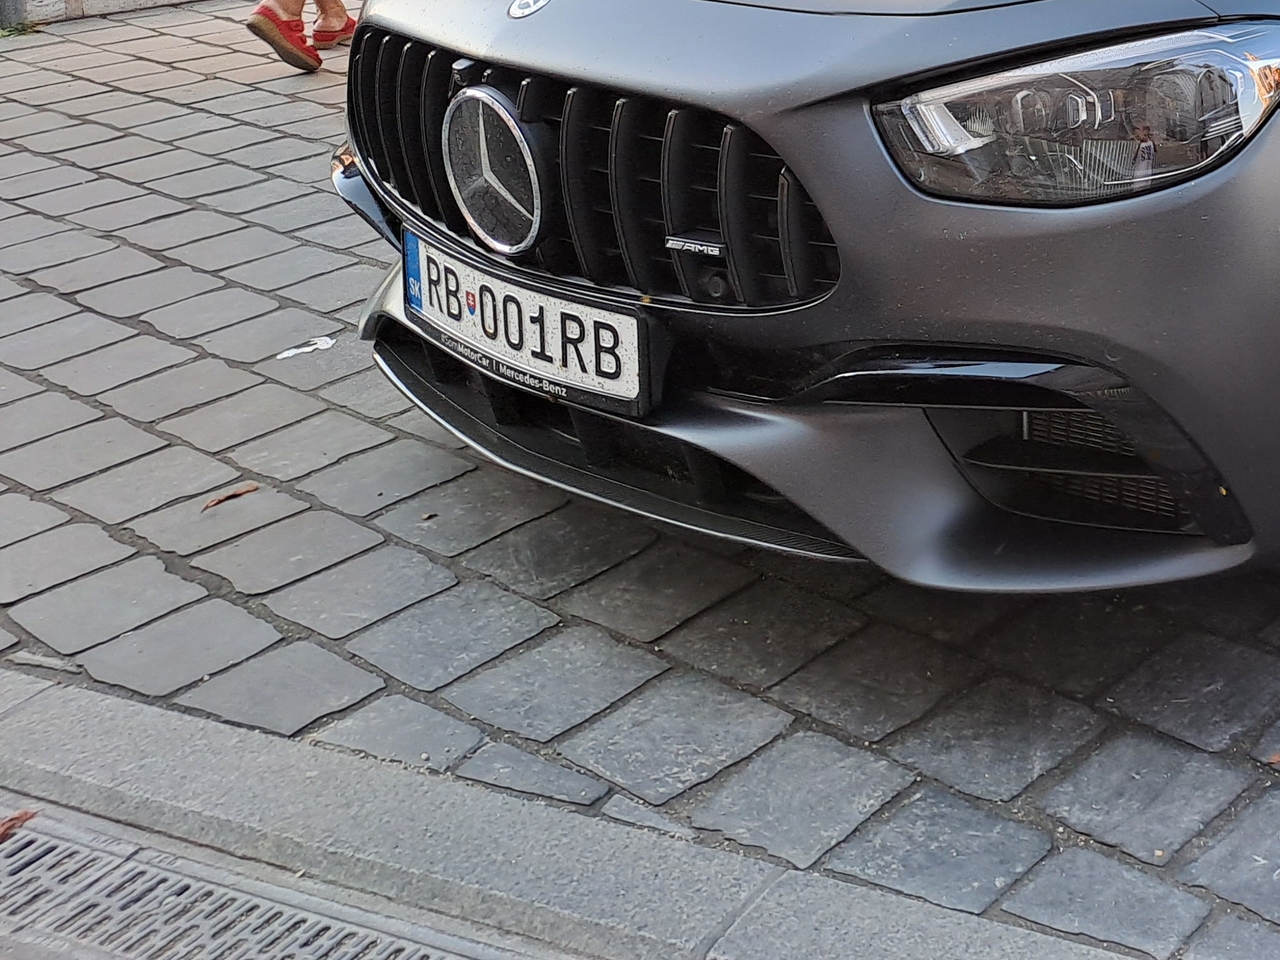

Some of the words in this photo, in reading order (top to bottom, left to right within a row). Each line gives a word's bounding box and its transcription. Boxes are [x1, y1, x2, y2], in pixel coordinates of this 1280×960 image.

[678, 242, 720, 256] AMG
[408, 276, 421, 300] SK
[500, 363, 568, 397] Mercedes-Benz
